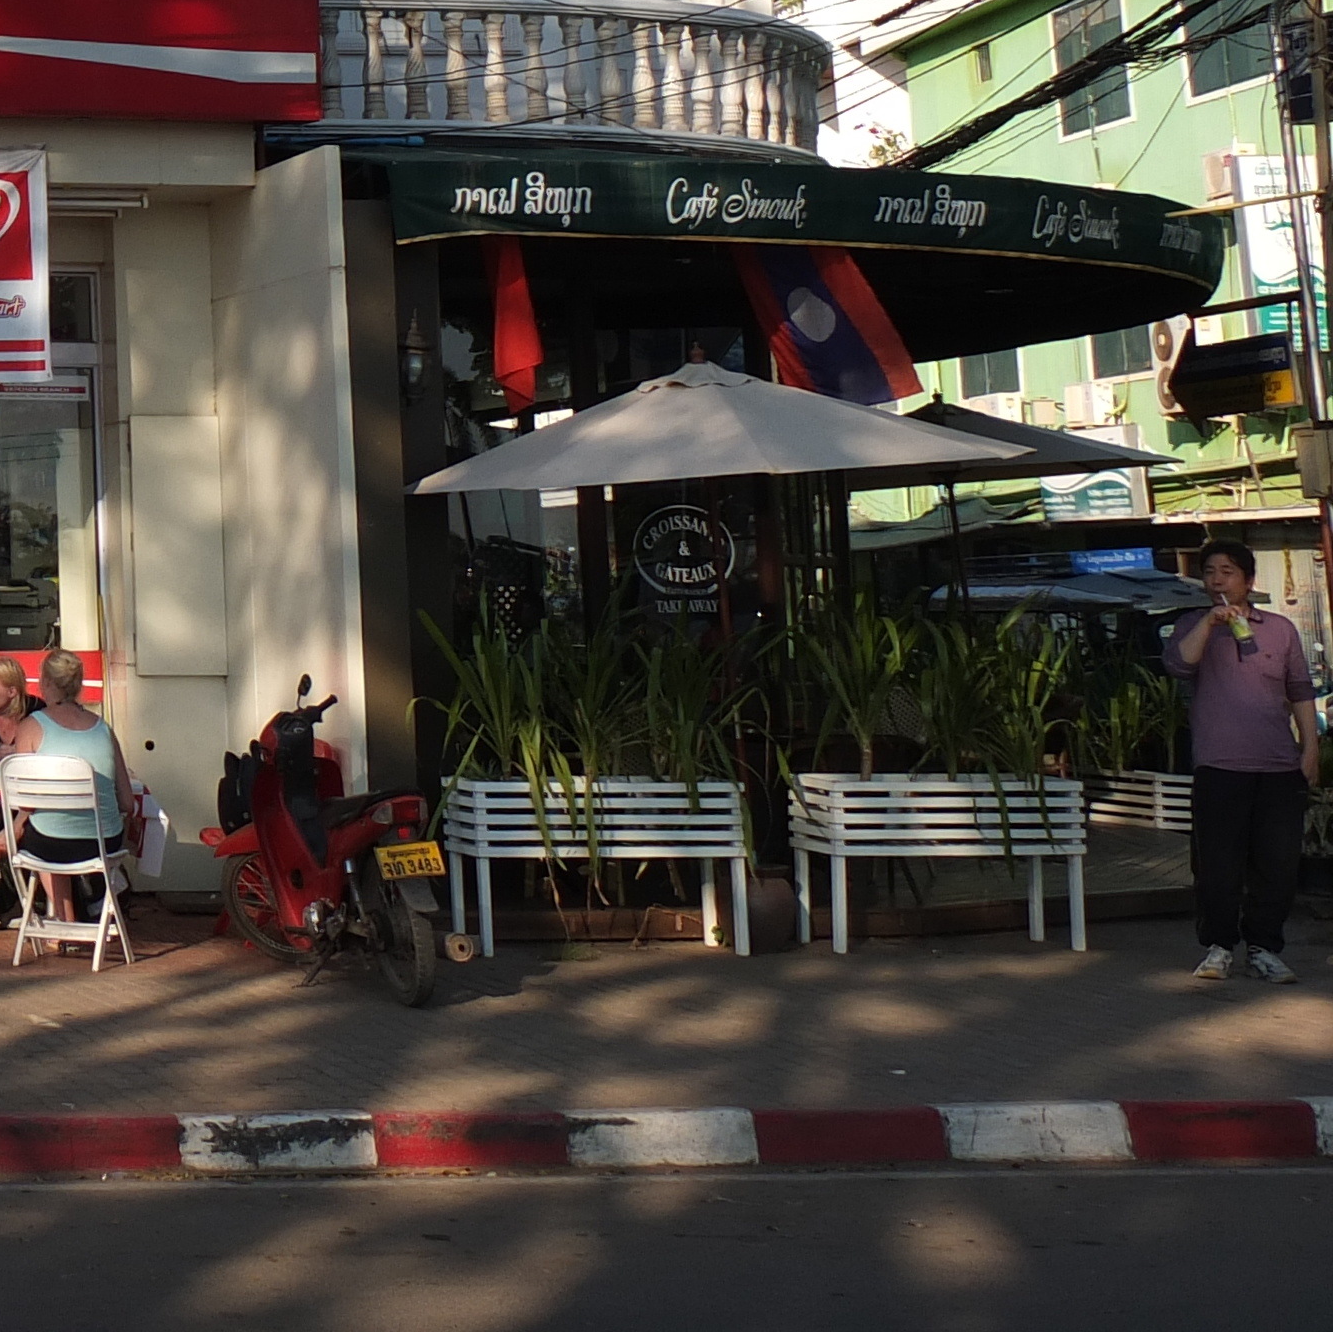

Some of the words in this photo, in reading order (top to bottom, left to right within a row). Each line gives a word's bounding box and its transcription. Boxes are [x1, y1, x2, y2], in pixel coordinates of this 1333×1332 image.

[666, 177, 718, 229] Café
[721, 178, 807, 229] Sinouk
[642, 514, 725, 550] CROISSAN
[678, 540, 691, 556] &
[407, 858, 442, 873] 3483
